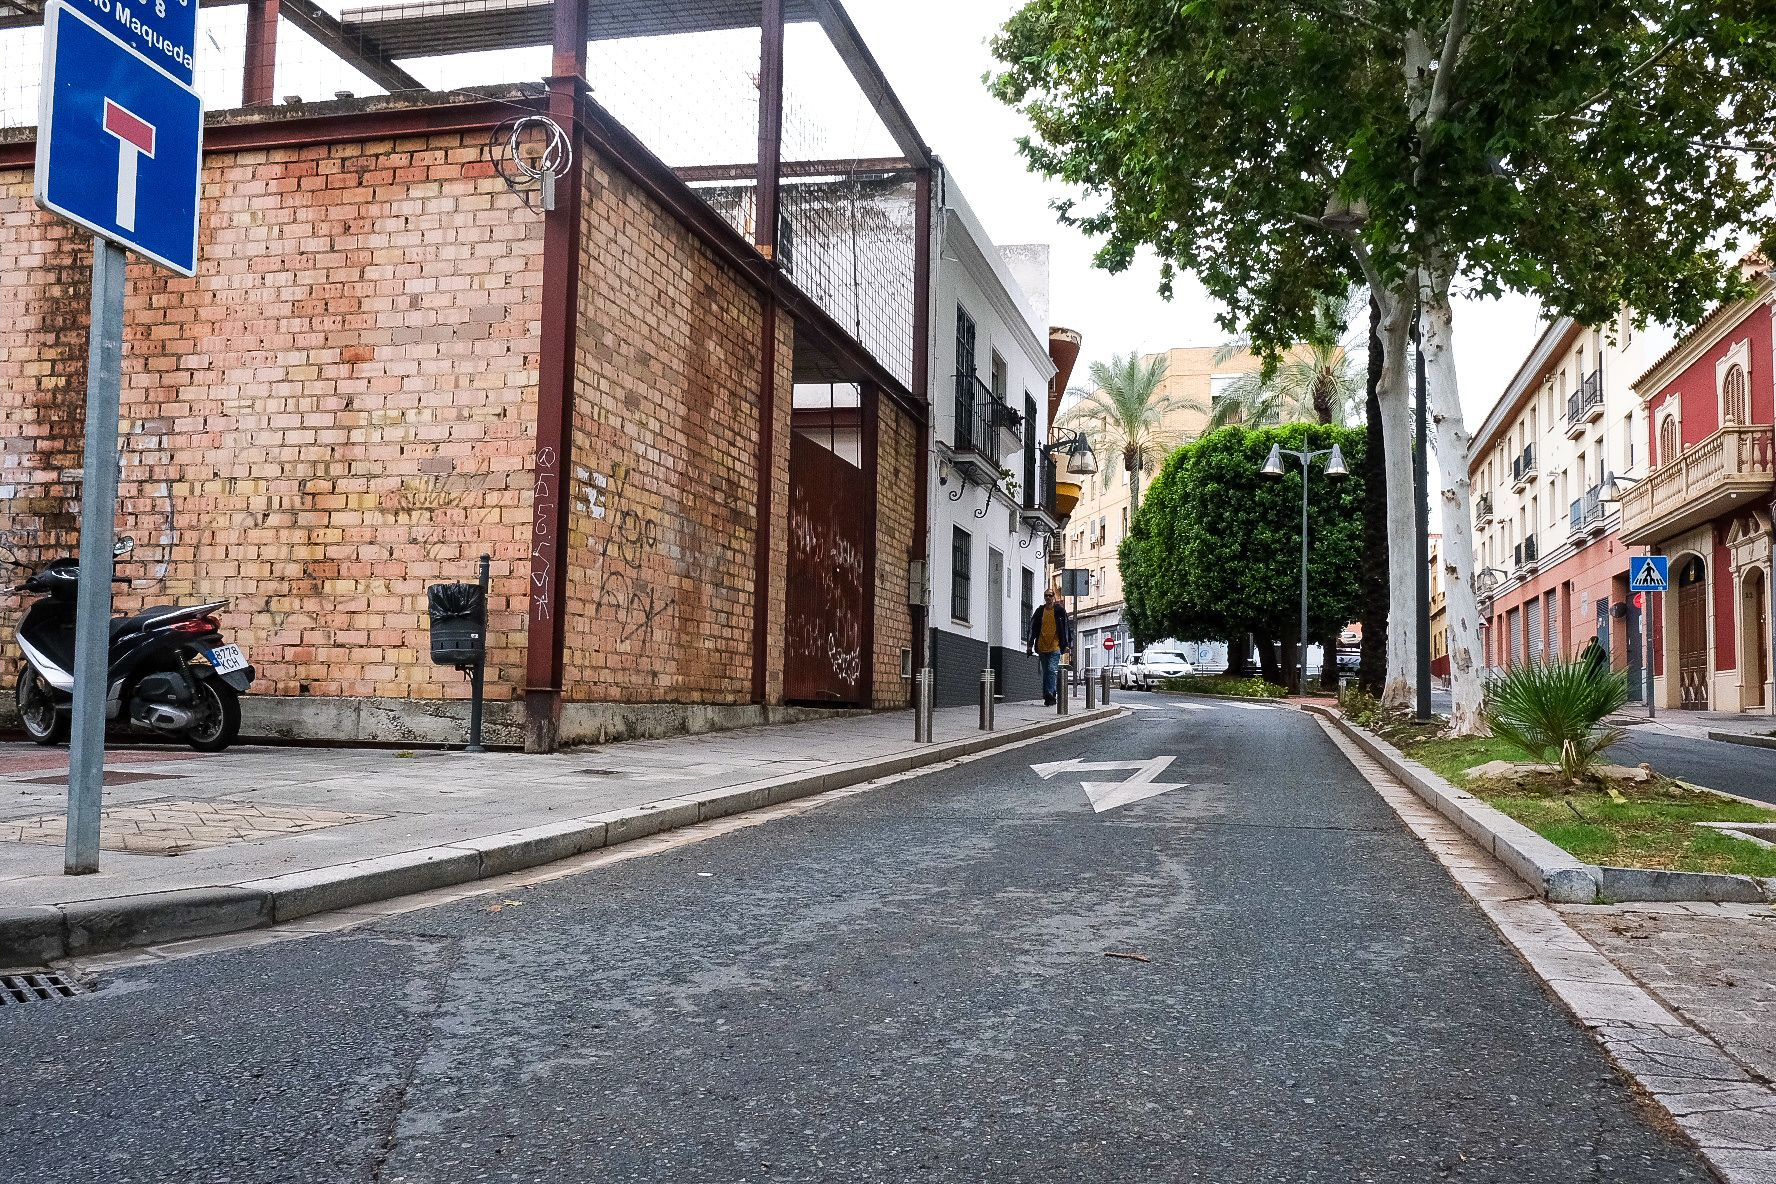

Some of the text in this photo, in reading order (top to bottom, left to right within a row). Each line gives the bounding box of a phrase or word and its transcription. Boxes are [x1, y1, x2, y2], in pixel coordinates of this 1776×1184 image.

[115, 2, 193, 70] Maqueda
[214, 645, 239, 660] 8778
[219, 656, 241, 671] KCH
